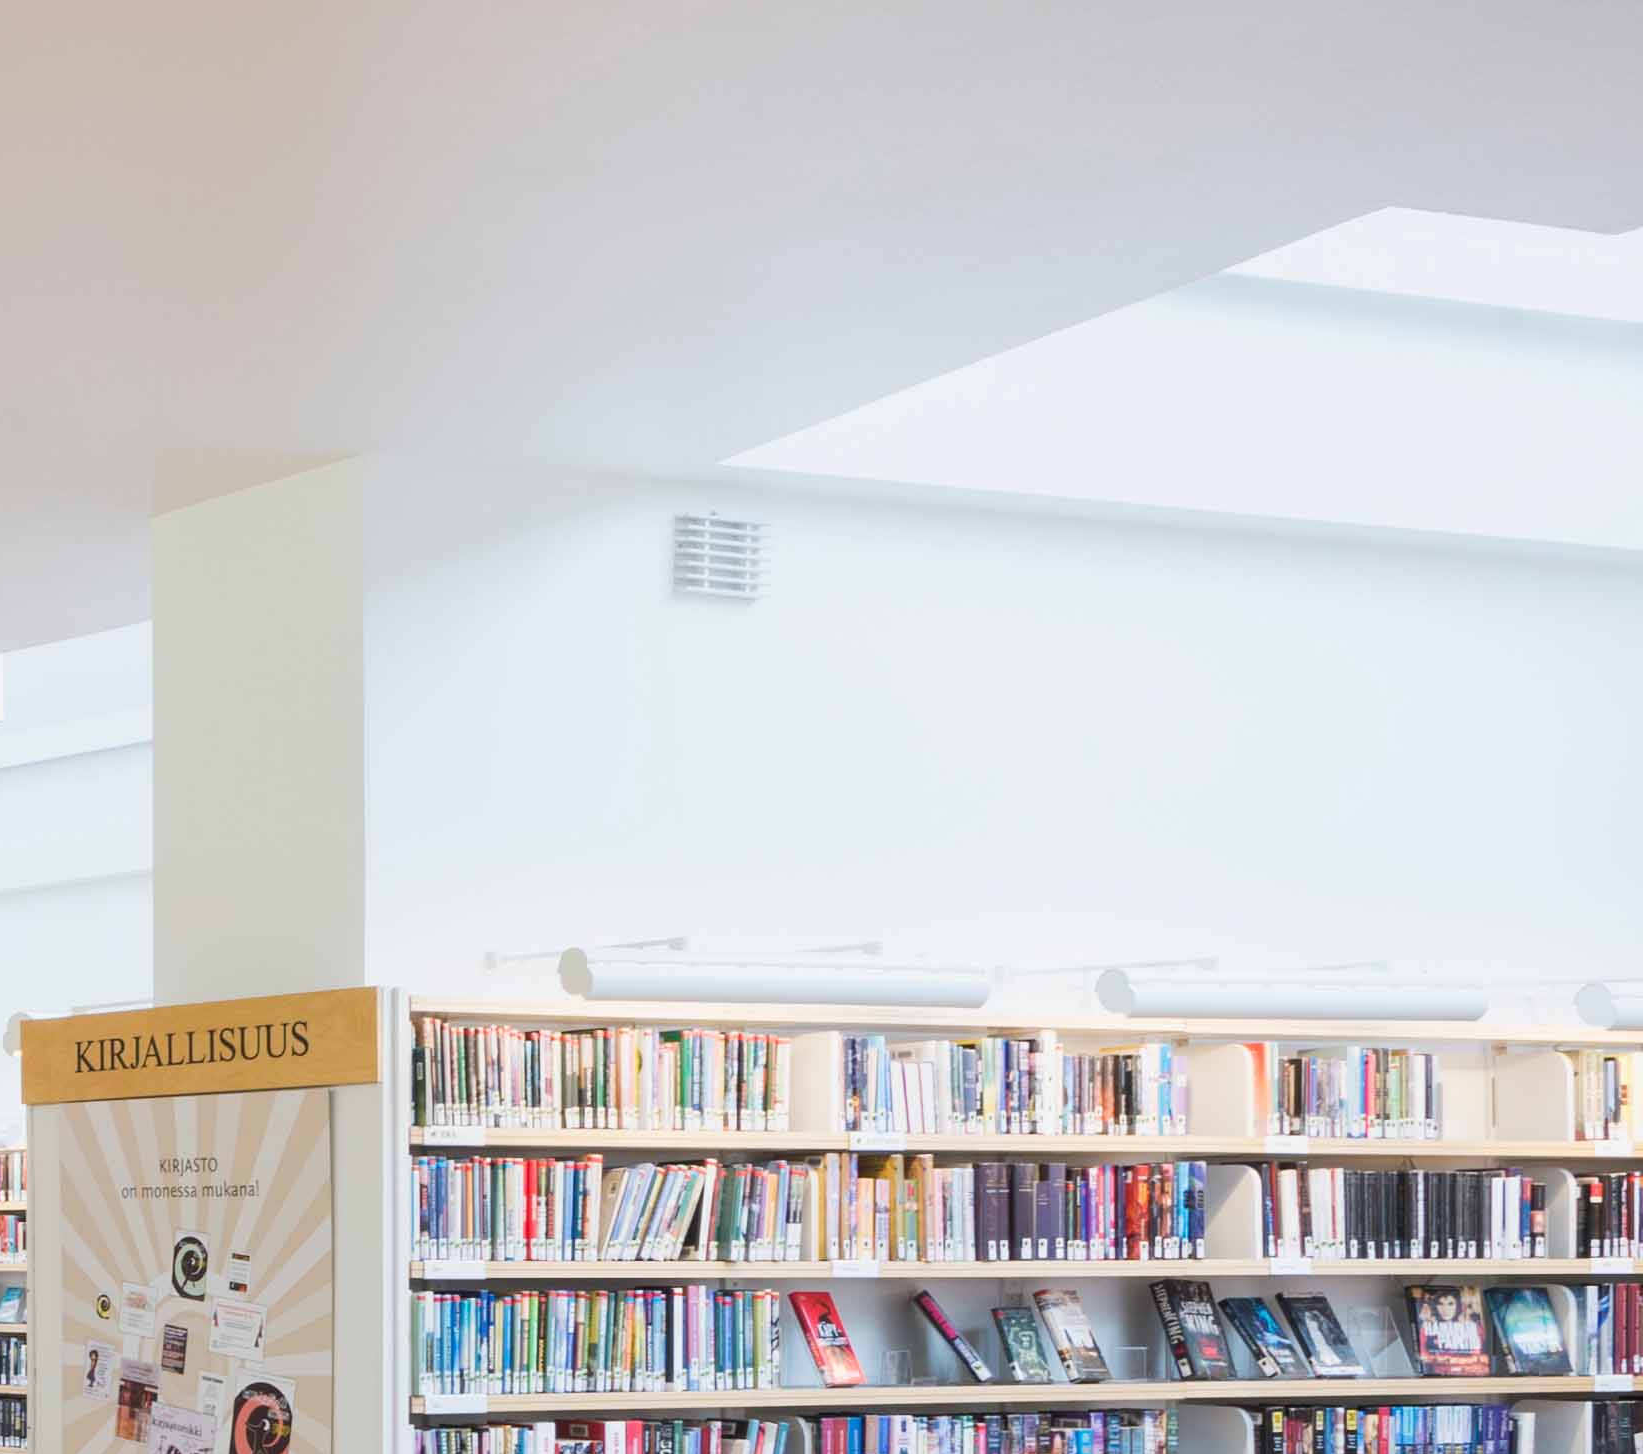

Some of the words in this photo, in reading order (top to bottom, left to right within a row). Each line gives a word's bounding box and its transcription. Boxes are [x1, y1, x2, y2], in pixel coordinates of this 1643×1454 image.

[74, 1020, 310, 1074] KIRJALLISUUS
[159, 1157, 219, 1176] KIRJASTO
[121, 1185, 137, 1199] on
[141, 1184, 197, 1199] monessa
[201, 1180, 260, 1198] mukana!
